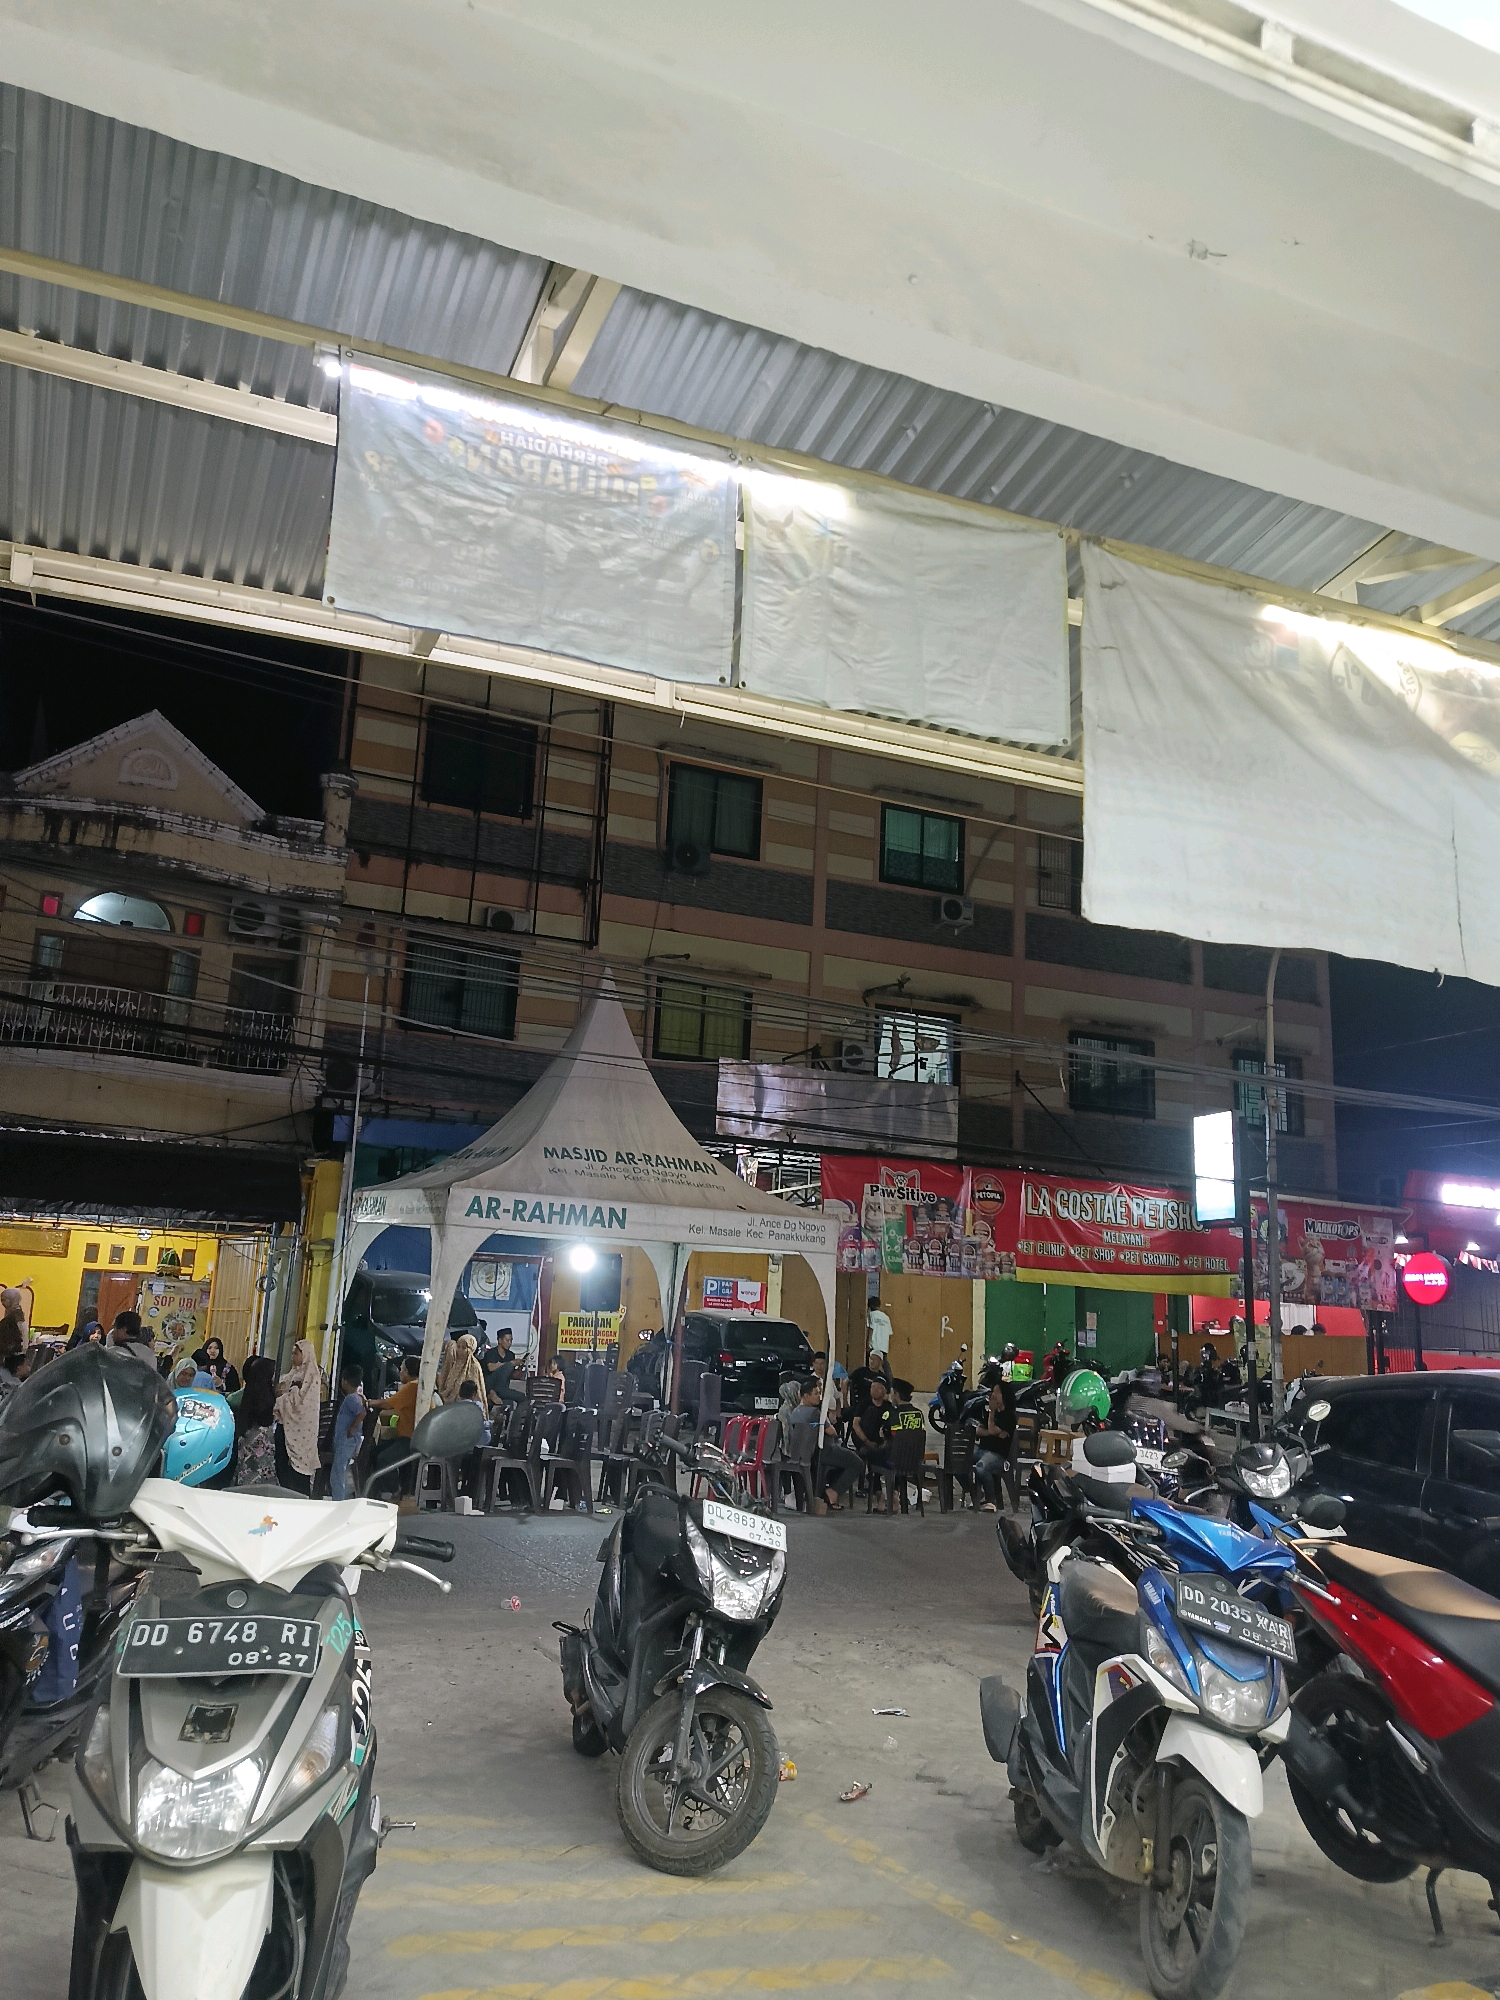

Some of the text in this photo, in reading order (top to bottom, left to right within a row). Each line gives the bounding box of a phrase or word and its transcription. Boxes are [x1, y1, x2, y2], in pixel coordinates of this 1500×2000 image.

[543, 1146, 718, 1176] MASJID AR-RAHMAN
[601, 1165, 630, 1174] Ance
[632, 1167, 650, 1177] Dg
[652, 1169, 687, 1180] Ngoyo
[465, 1195, 627, 1230] AR-RAHMAN
[1025, 1183, 1052, 1218] LA
[1056, 1188, 1128, 1226] COSTAE
[688, 1223, 706, 1235] Kel.
[709, 1226, 741, 1238] Masale
[768, 1230, 826, 1245] Panakkukang
[759, 1218, 781, 1229] Ance
[784, 1219, 797, 1232] Dg
[799, 1221, 826, 1234] Ngoyo
[1102, 1231, 1144, 1247] MELAYANI
[1037, 1243, 1066, 1257] CLINIC
[1075, 1246, 1115, 1262] PET SHOP
[1124, 1251, 1181, 1268] PET GROMING
[1187, 1256, 1230, 1272] PET HOTEL
[153, 1295, 175, 1308] SOP
[726, 1510, 756, 1529] 2963
[1143, 1580, 1161, 1605] YAMAHA
[1184, 1585, 1206, 1605] DD
[1210, 1597, 1252, 1623] 2035
[1187, 1612, 1212, 1626] YAMAHA
[131, 1622, 311, 1648] DD 6748 RI
